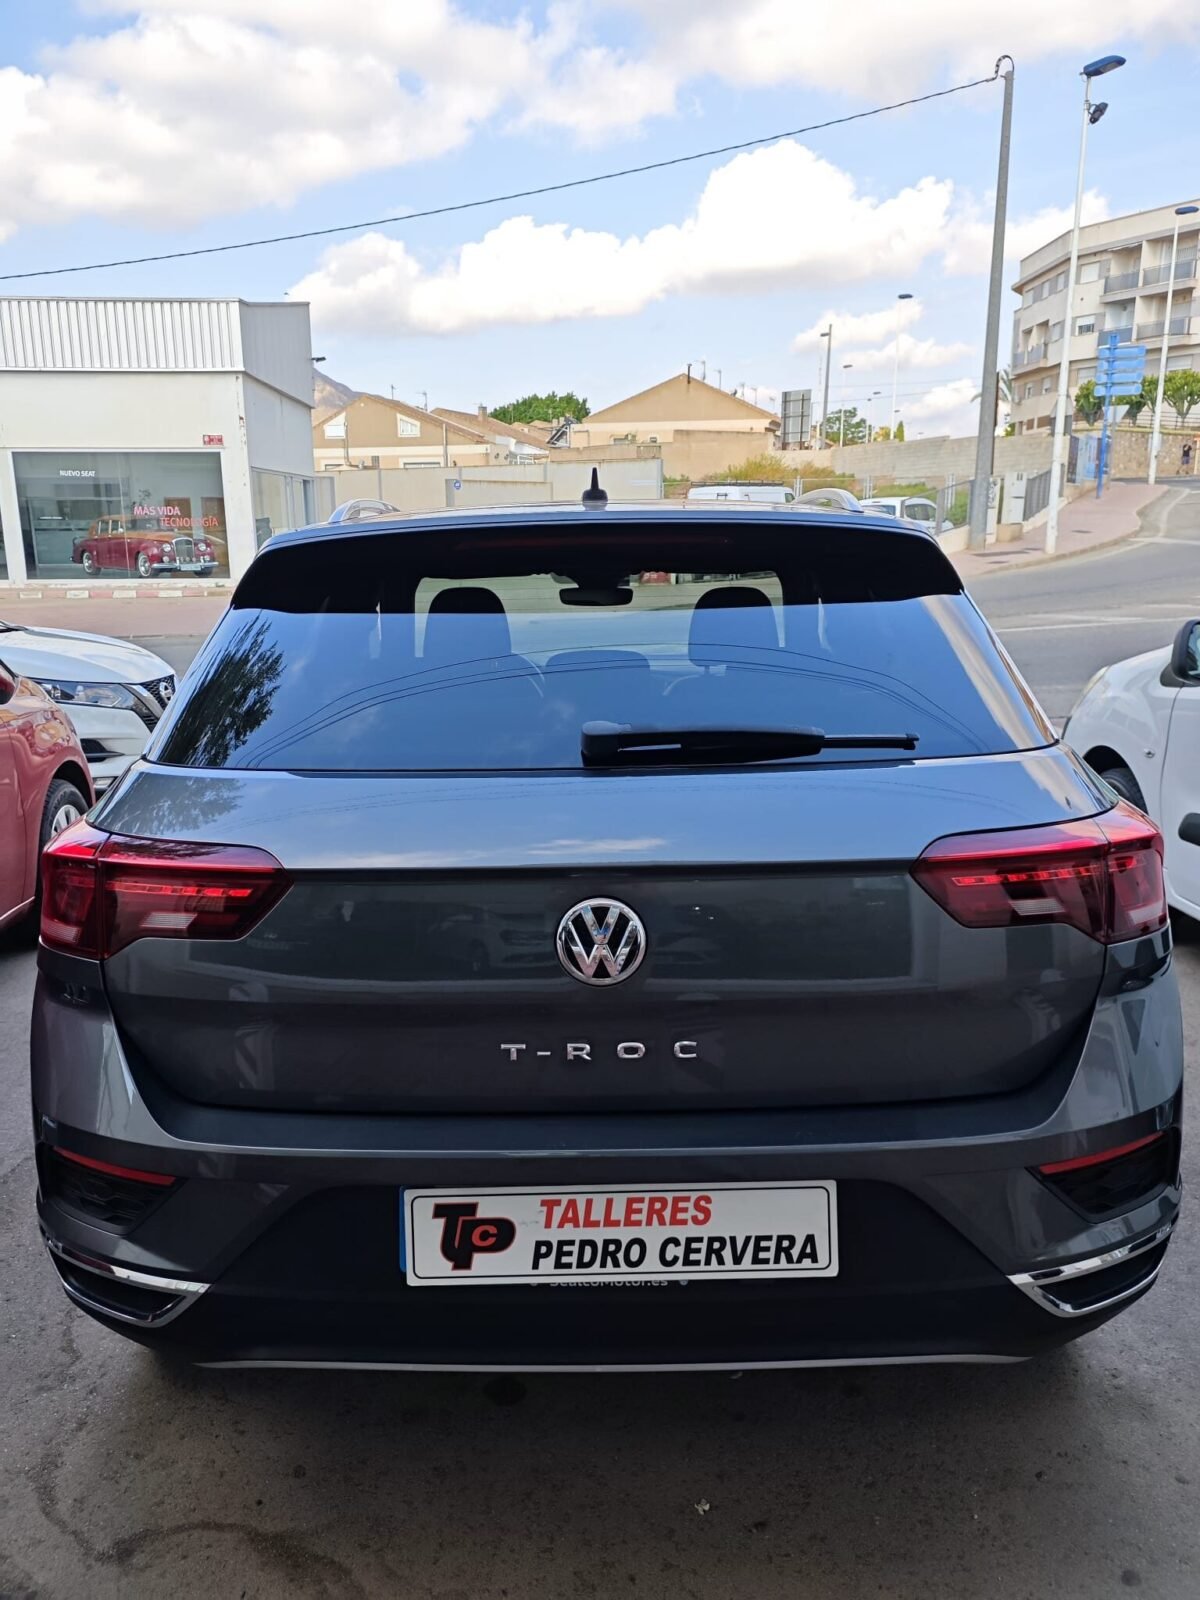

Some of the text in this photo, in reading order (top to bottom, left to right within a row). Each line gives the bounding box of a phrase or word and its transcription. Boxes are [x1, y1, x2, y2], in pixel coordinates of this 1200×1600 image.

[134, 505, 181, 516] MÁS VIDA
[540, 1195, 713, 1229] TALLERES
[531, 1233, 819, 1270] PEDRO CERVERA
